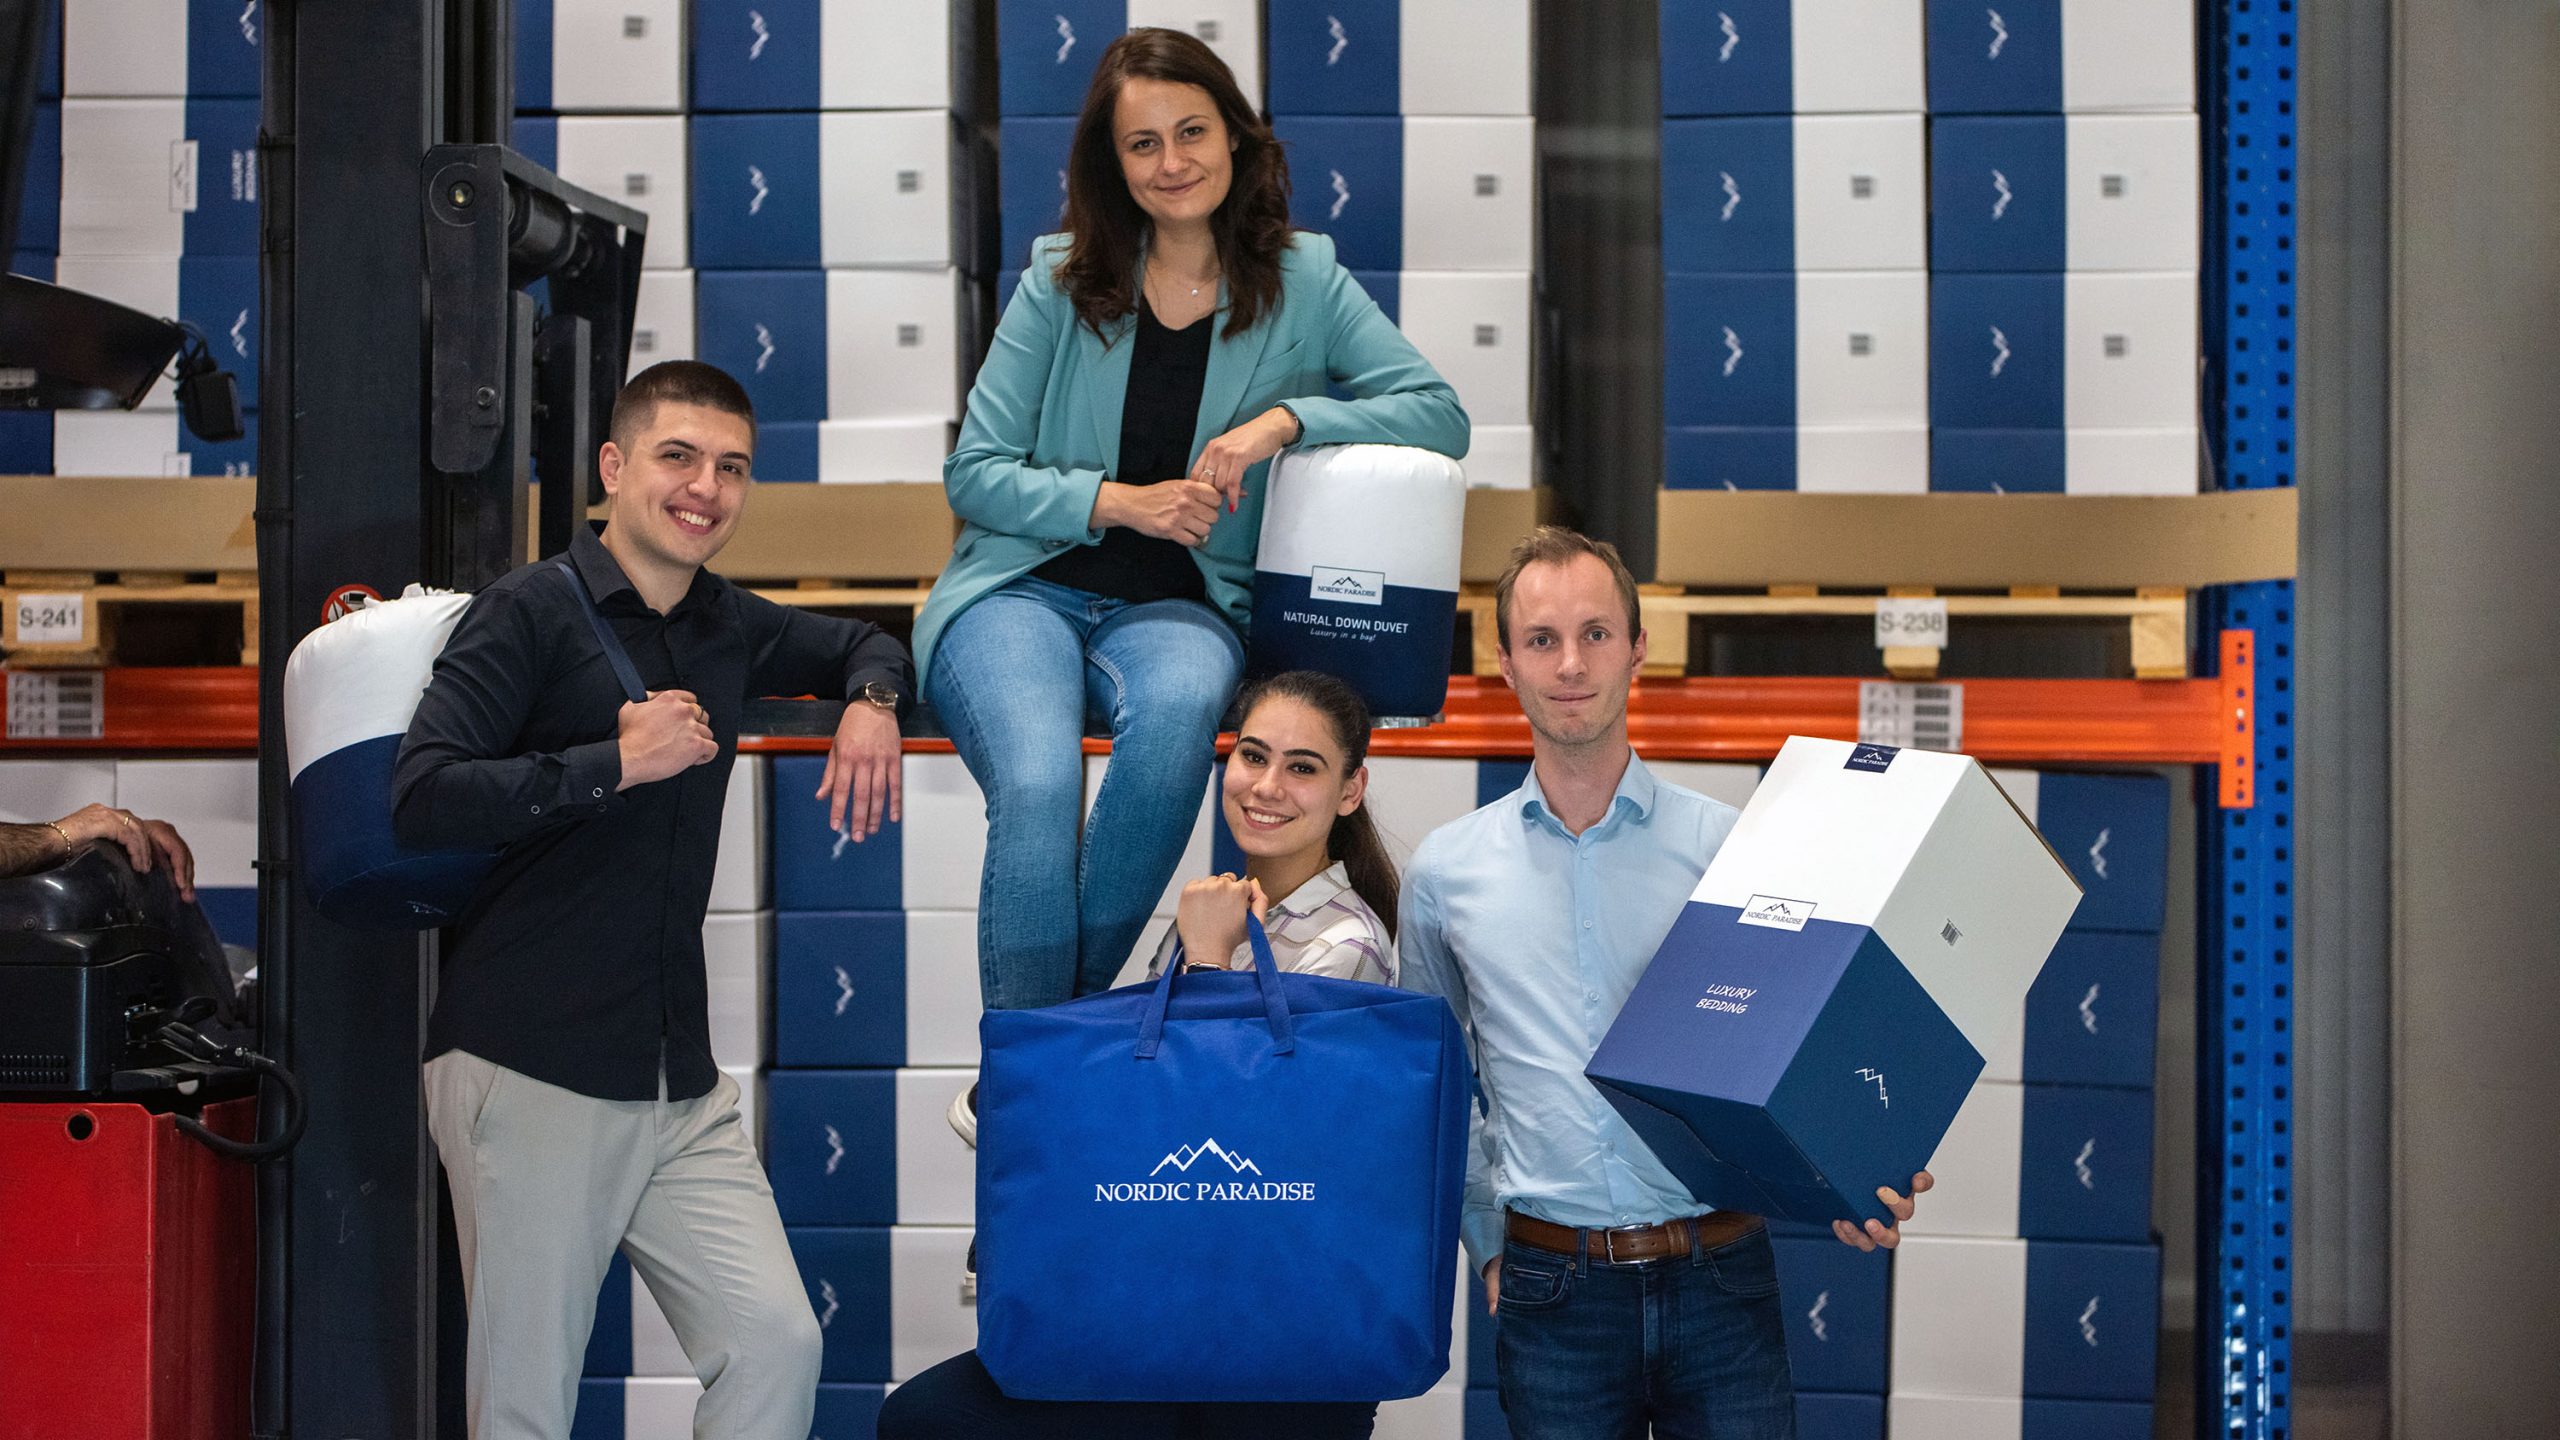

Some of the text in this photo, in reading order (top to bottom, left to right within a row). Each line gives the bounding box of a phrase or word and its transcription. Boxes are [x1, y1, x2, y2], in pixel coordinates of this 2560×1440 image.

[20, 607, 77, 628] S-241
[1283, 610, 1409, 633] NATURAL DOWN DUVET
[1879, 612, 1942, 632] S-238
[1310, 628, 1337, 639] Luxury
[1360, 634, 1377, 643] bag!
[1706, 984, 1757, 1000] LUXURY
[1696, 998, 1748, 1014] BEDDING
[1095, 1182, 1316, 1202] NORDIC PARADISE
